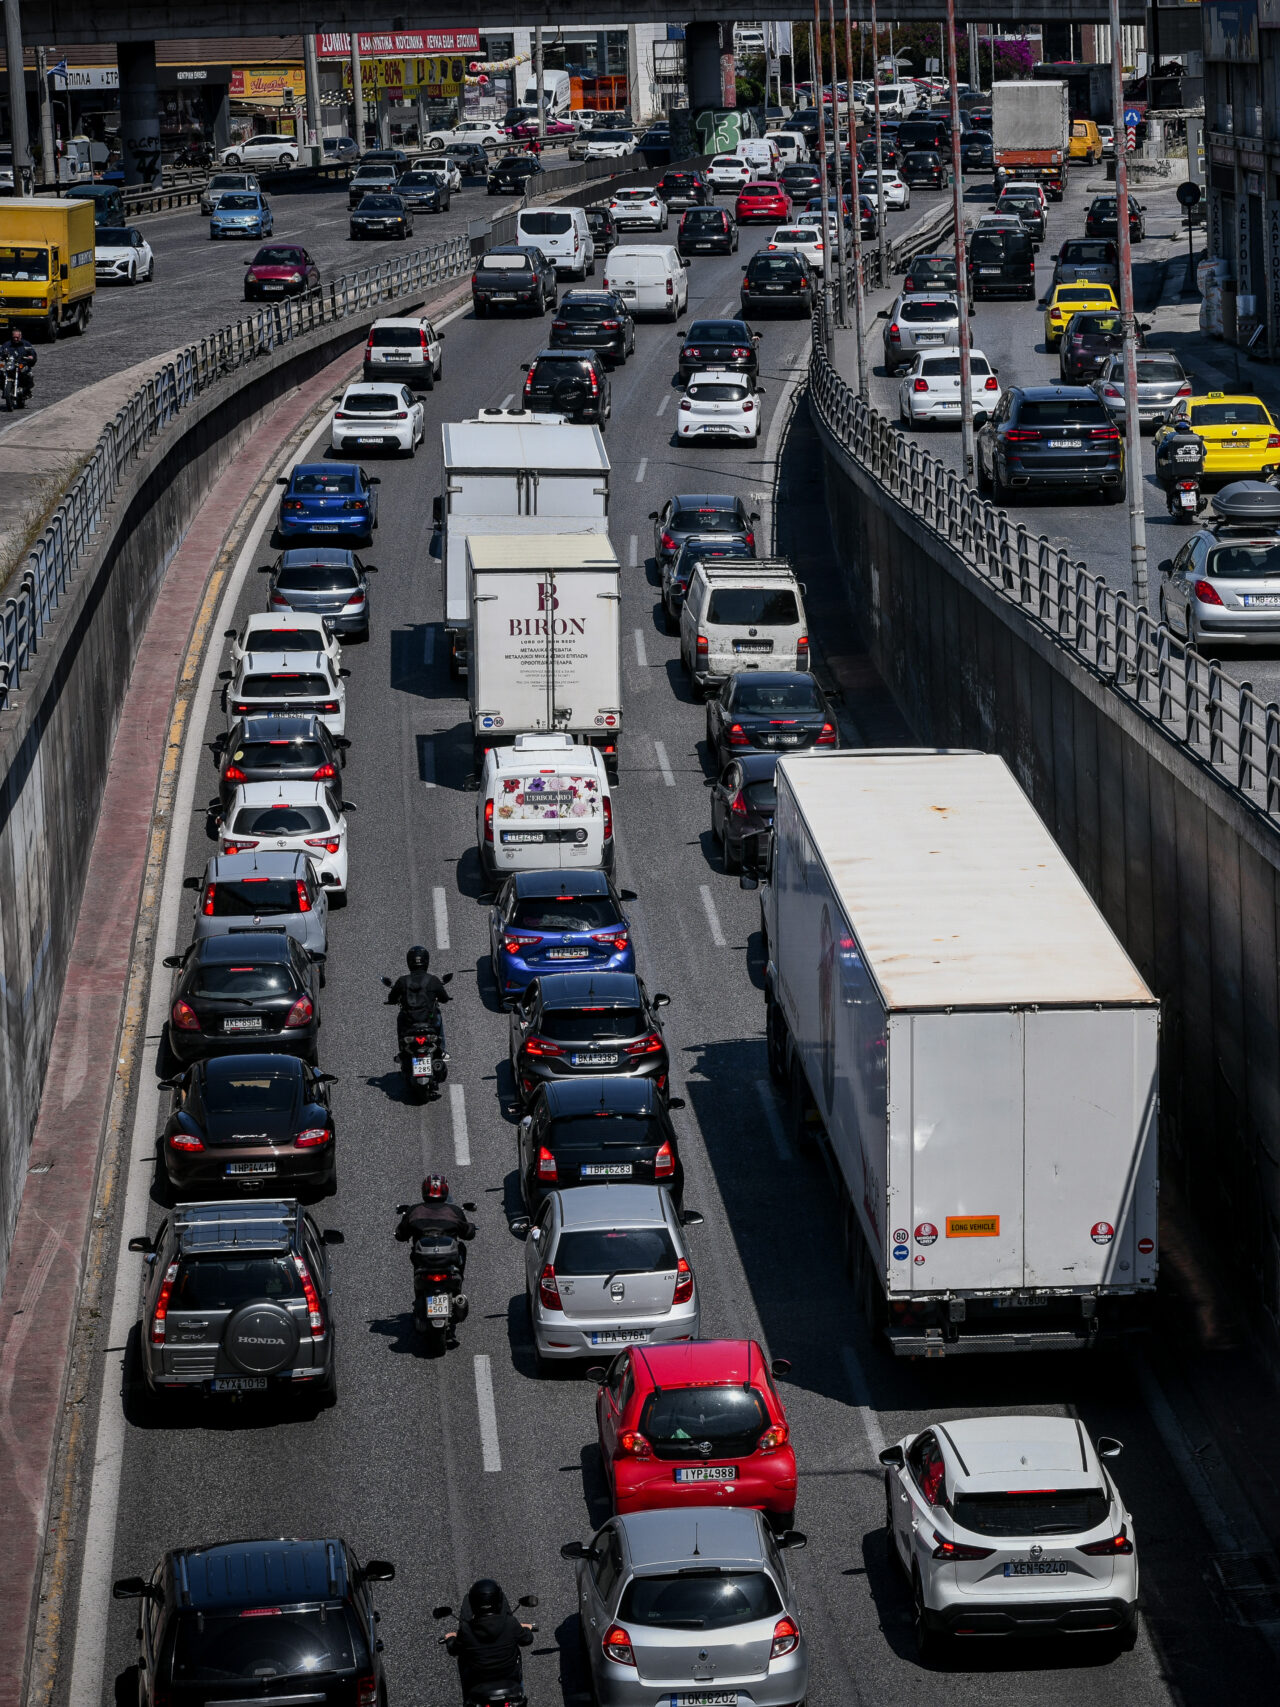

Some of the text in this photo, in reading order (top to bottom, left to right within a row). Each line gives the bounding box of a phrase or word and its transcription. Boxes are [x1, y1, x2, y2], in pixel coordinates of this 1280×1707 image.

[509, 618, 586, 636] BIRON
[951, 1222, 995, 1231] LONG VEHICLE
[896, 1232, 906, 1241] 80
[238, 1336, 286, 1345] HONDA
